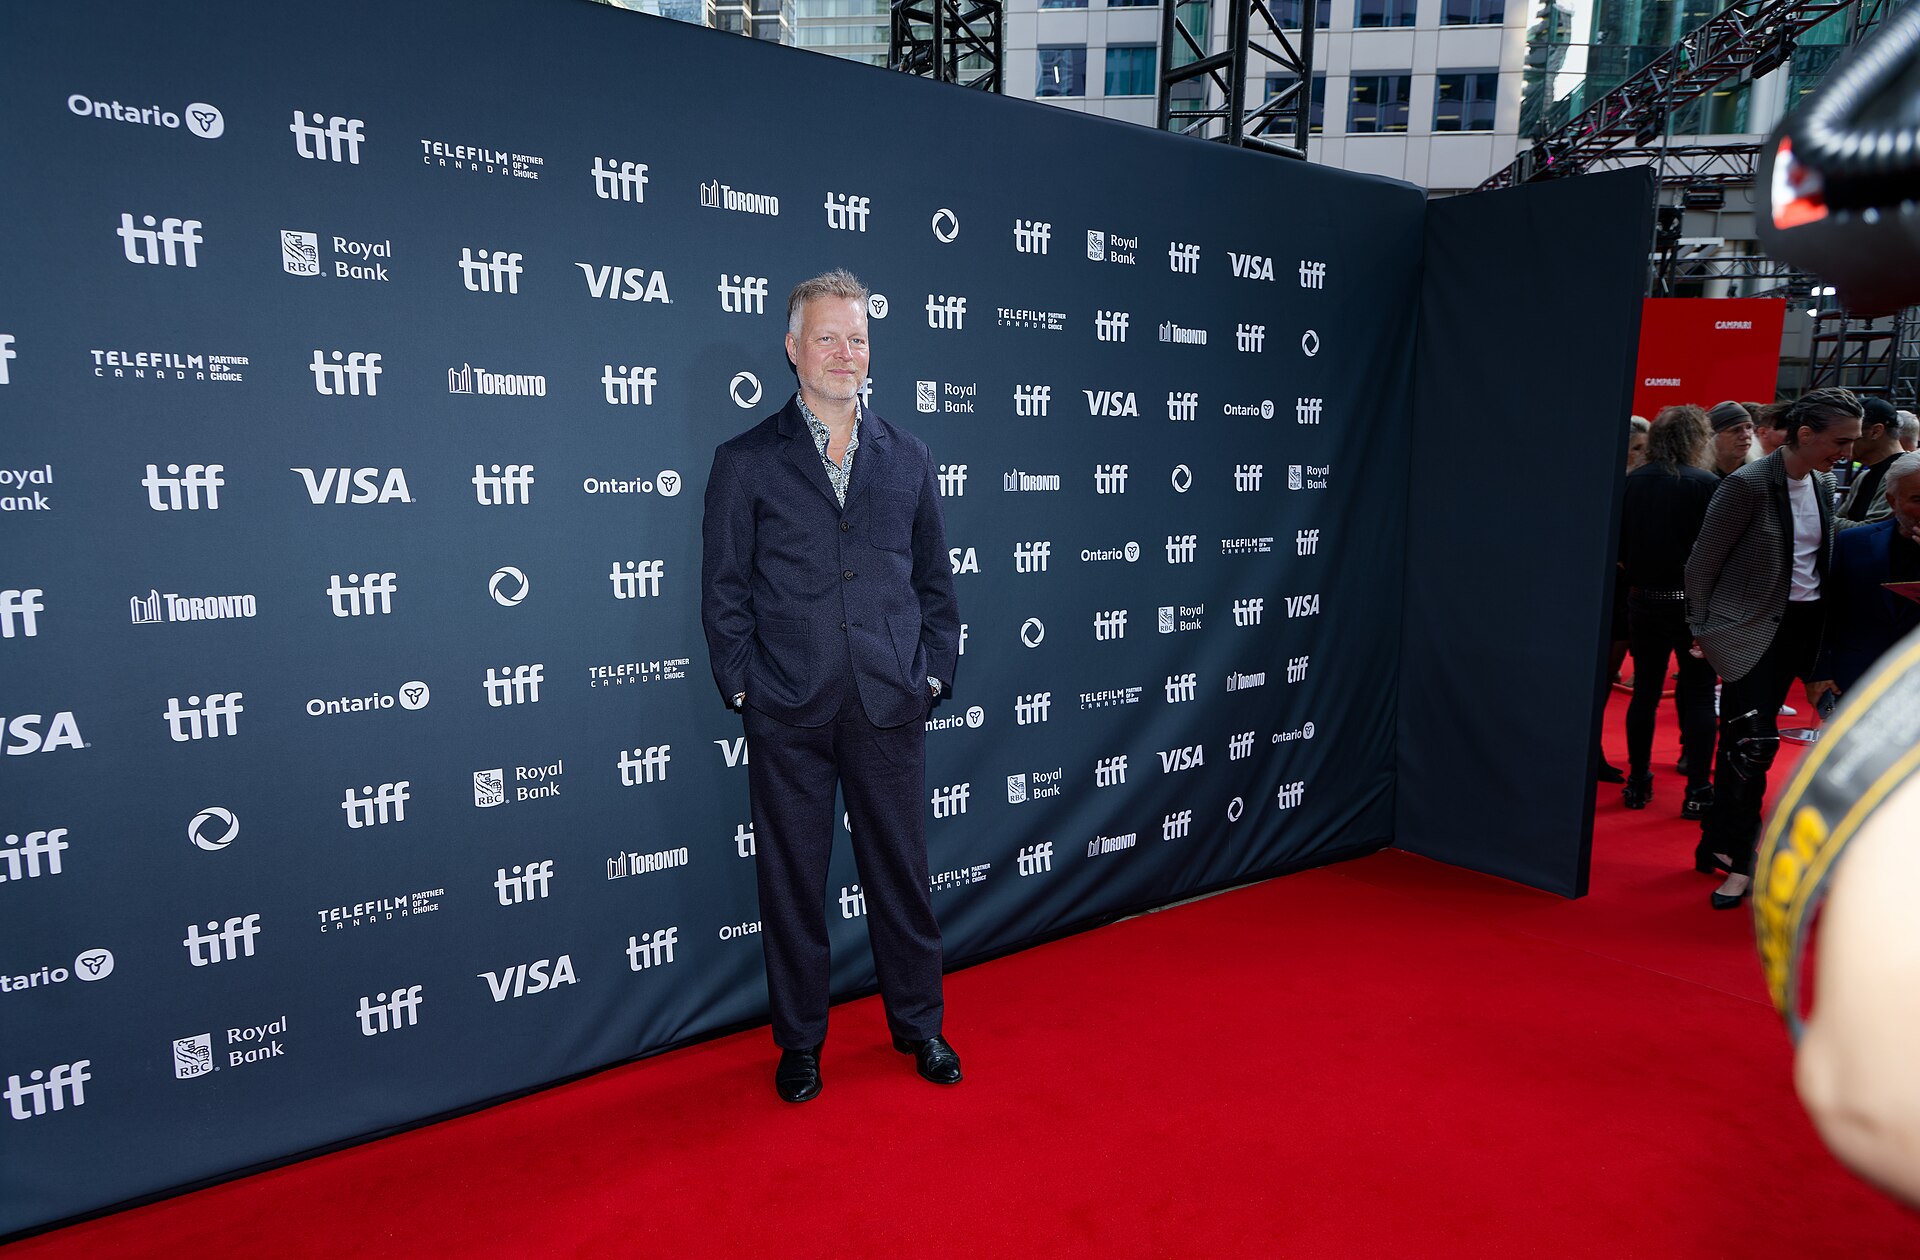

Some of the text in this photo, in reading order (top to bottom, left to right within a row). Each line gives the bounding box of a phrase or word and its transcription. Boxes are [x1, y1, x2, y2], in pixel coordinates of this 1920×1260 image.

[68, 94, 180, 128] Ontario
[290, 111, 365, 164] tiff
[421, 139, 508, 165] TELEFILM
[512, 153, 544, 165] PARTNER
[513, 161, 522, 169] OF
[424, 156, 508, 176] CANADA
[513, 169, 538, 179] CHOICE
[591, 157, 648, 203] tiff
[719, 185, 778, 216] TORONTO
[824, 192, 870, 232] tiff
[117, 213, 203, 267] tiff
[333, 237, 391, 260] Royal
[1014, 219, 1051, 254] tiff
[1111, 234, 1137, 250] Royal
[288, 262, 315, 273] RBC
[335, 261, 389, 281] Bank
[459, 248, 523, 294] tiff
[1110, 251, 1135, 265] Bank
[1169, 242, 1200, 274] tiff
[1227, 252, 1275, 281] VISA
[575, 263, 669, 303] VISA
[1299, 260, 1326, 289] tiff
[718, 274, 768, 314] tiff
[926, 294, 966, 329] tiff
[997, 308, 1045, 321] TELEFILM
[1095, 310, 1129, 342] tiff
[1172, 324, 1207, 345] TORONTO
[1236, 324, 1265, 352] tiff
[91, 350, 203, 369] TELEFILM
[209, 355, 249, 365] PARTNER
[210, 364, 222, 372] OF
[310, 350, 382, 396] tiff
[95, 368, 204, 380] CANADA
[210, 372, 242, 381] CHOICE
[472, 368, 546, 396] TORONTO
[601, 365, 657, 405] tiff
[945, 383, 976, 399] Royal
[1014, 385, 1050, 416] tiff
[1082, 390, 1140, 416] VISA
[945, 400, 974, 413] Bank
[1167, 392, 1198, 421] tiff
[1224, 404, 1259, 416] Ontario
[1296, 398, 1322, 424] tiff
[0, 465, 53, 490] oyal
[472, 465, 534, 505] tiff
[937, 465, 967, 496] iff
[1017, 472, 1060, 491] TORONTO
[1094, 464, 1128, 494] tiff
[1234, 464, 1263, 491] tiff
[1307, 465, 1329, 478] Royal
[1307, 479, 1327, 489] Bank
[142, 464, 224, 511] tiff
[290, 468, 411, 504] VISA
[584, 478, 653, 493] Ontario
[0, 491, 51, 511] ank
[1081, 548, 1122, 561] Ontario
[1166, 535, 1196, 563] tiff
[1221, 538, 1257, 548] TELEFILM
[1296, 529, 1319, 556] tiff
[949, 548, 978, 574] SA
[1014, 541, 1050, 573] tiff
[610, 560, 663, 599] tiff
[162, 594, 256, 622] TORONTO
[327, 573, 396, 617] tiff
[1284, 594, 1319, 618] VISA
[0, 589, 44, 638] ff
[1180, 603, 1204, 618] Royal
[1233, 598, 1263, 626] tiff
[1094, 610, 1127, 640] tiff
[1180, 619, 1201, 631] Bank
[589, 661, 660, 679] TELEFILM
[663, 658, 689, 667] PARTNER
[1287, 656, 1309, 683] tiff
[483, 664, 544, 707] tiff
[591, 674, 660, 687] CANADA
[1165, 673, 1196, 703] tiff
[1236, 672, 1265, 690] TORONTO
[307, 693, 394, 715] Ontario
[1015, 692, 1050, 725] tiff
[1080, 689, 1124, 703] TELEFILM
[163, 692, 243, 741] tiff
[925, 715, 963, 731] ntario
[1229, 731, 1255, 760] tiff
[1272, 729, 1302, 743] Ontario
[516, 759, 562, 781] Royal
[617, 745, 670, 786] tiff
[1095, 755, 1127, 787] tiff
[1156, 745, 1204, 773] VISA
[1033, 767, 1062, 784] Royal
[342, 781, 410, 828] tiff
[478, 795, 502, 805] RBC
[517, 781, 560, 801] Bank
[931, 783, 970, 818] tiff
[1033, 784, 1060, 799] Bank
[1278, 781, 1304, 809] tiff
[1162, 810, 1191, 840] tiff
[735, 822, 756, 857] ti
[1101, 833, 1136, 853] TORONTO
[0, 828, 69, 882] iff
[627, 847, 688, 876] TORONTO
[1017, 842, 1053, 876] tiff
[494, 860, 553, 905] tiff
[929, 868, 969, 885] LEFILM
[412, 889, 444, 900] PARTNER
[318, 895, 407, 923] TELEFILM
[320, 910, 408, 933] CANADA
[413, 904, 438, 915] CHOICE
[183, 914, 260, 966] tiff
[626, 927, 677, 971] tiff
[0, 967, 68, 992] tario
[477, 955, 576, 1002] VISA
[356, 985, 422, 1036] tiff
[227, 1016, 286, 1044] Royal
[229, 1041, 284, 1066] Bank
[180, 1062, 210, 1077] RBC
[3, 1060, 91, 1120] tiff
